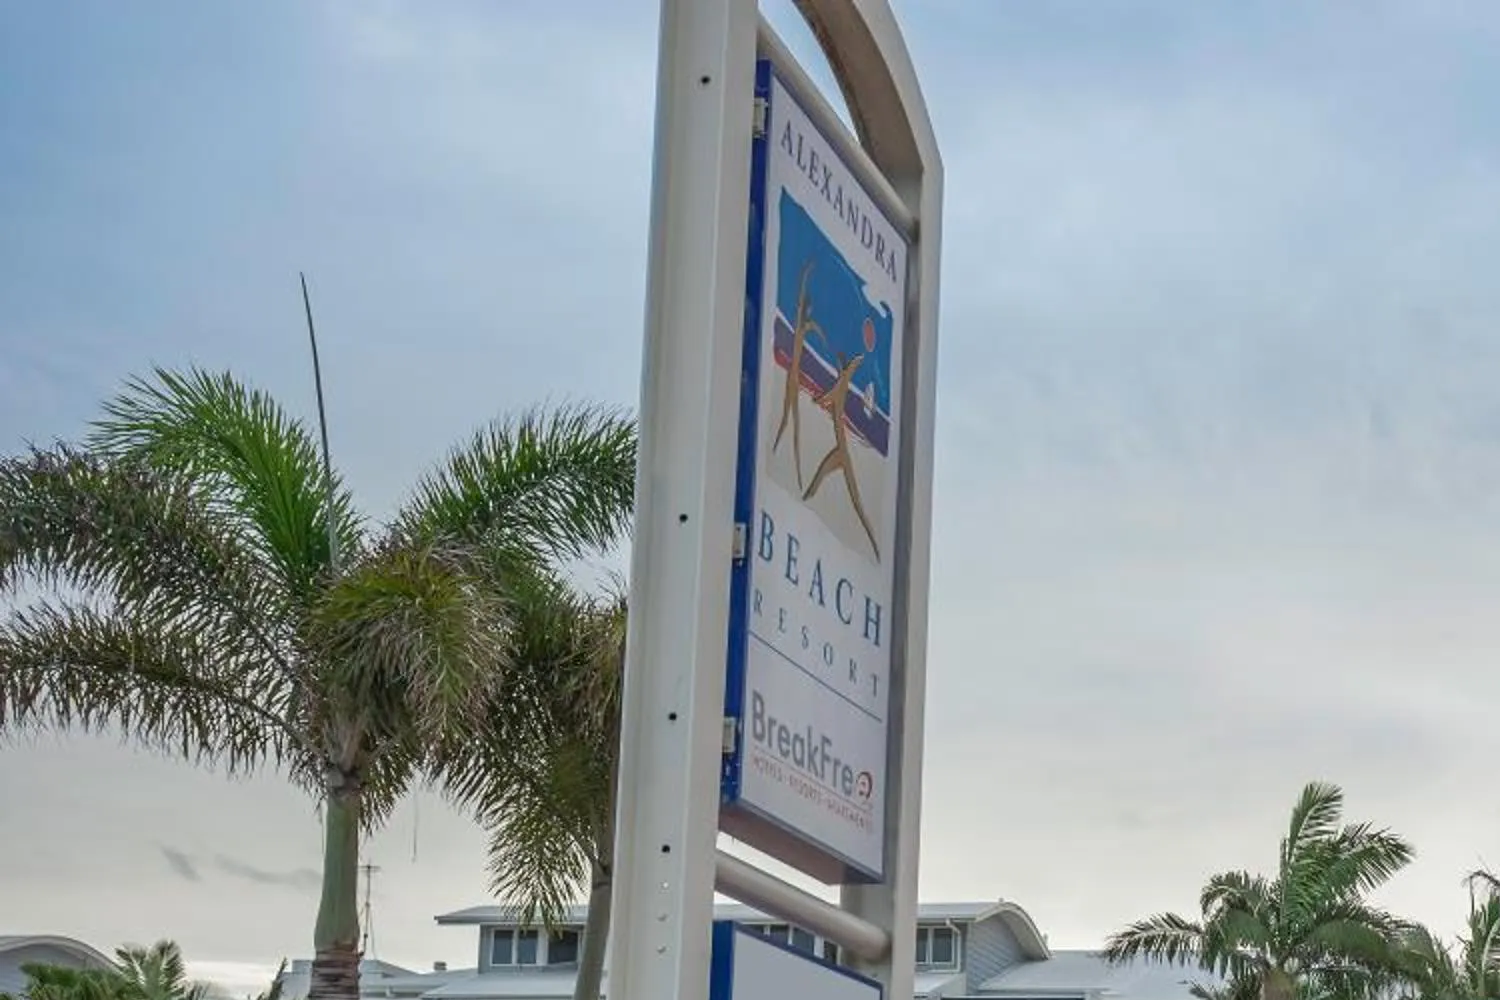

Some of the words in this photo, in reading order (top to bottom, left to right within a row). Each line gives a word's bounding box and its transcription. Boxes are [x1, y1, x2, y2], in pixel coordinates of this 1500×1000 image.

[780, 119, 898, 284] ALEXANDRA
[753, 587, 881, 699] RESORT
[757, 507, 883, 648] BEACH
